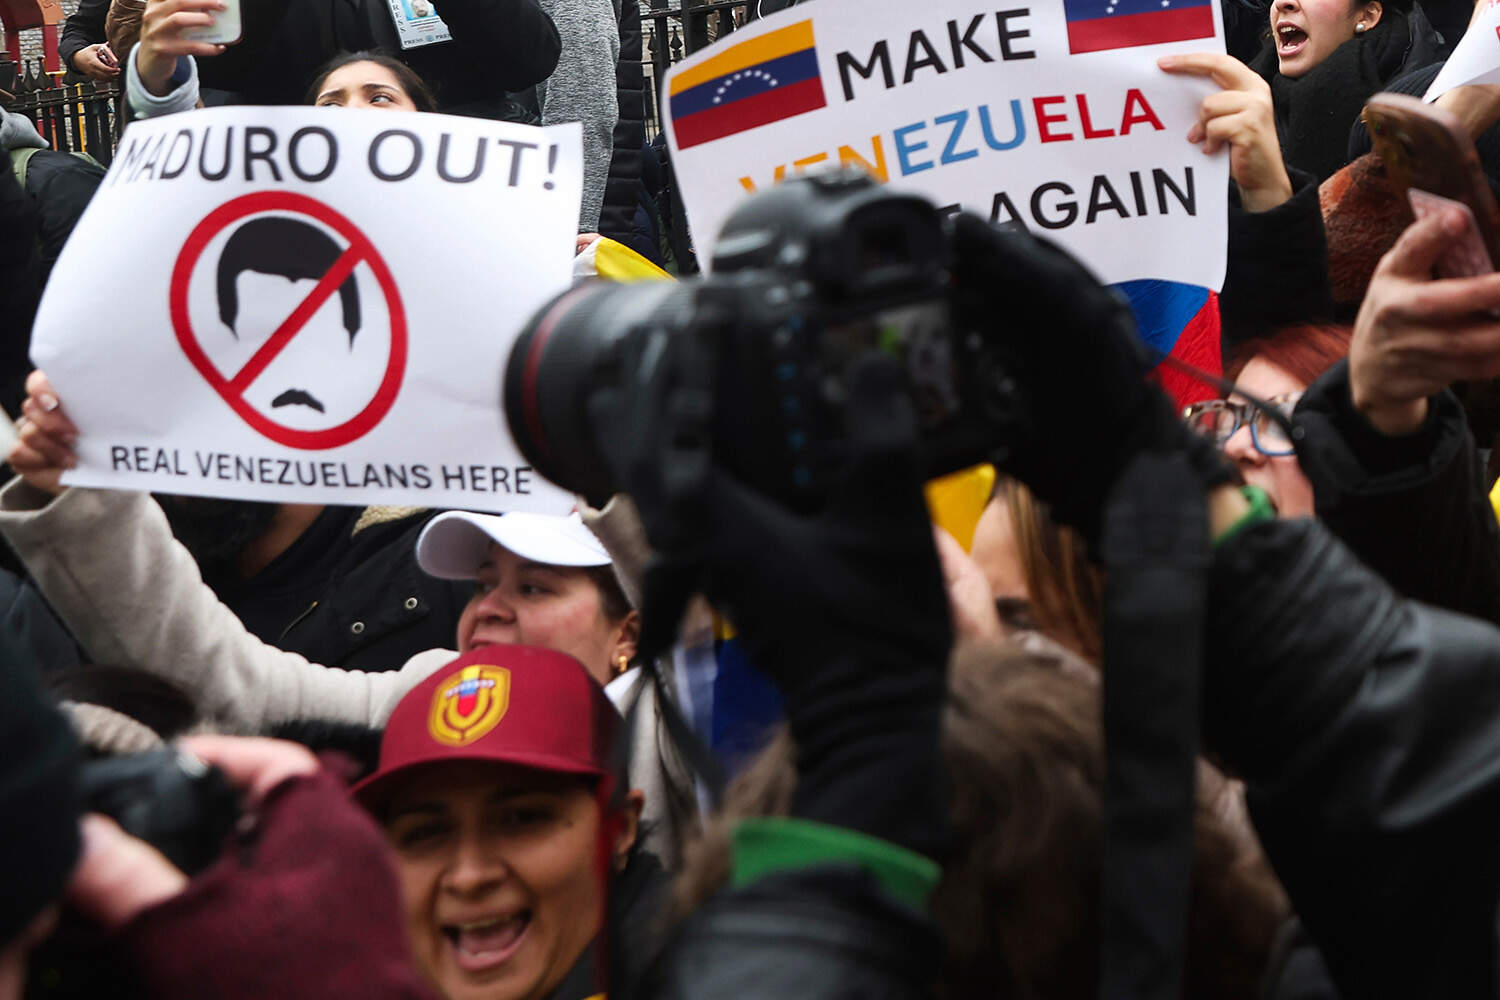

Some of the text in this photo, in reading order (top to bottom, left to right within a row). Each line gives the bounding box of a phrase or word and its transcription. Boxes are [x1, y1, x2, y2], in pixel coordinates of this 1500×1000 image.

[836, 7, 1037, 102] MAKE
[110, 126, 559, 190] MADURO OUT!
[739, 87, 1166, 193] NEZUELA
[989, 166, 1197, 234] AGAIN
[111, 445, 533, 496] REAL VENEZUELANS HERE
